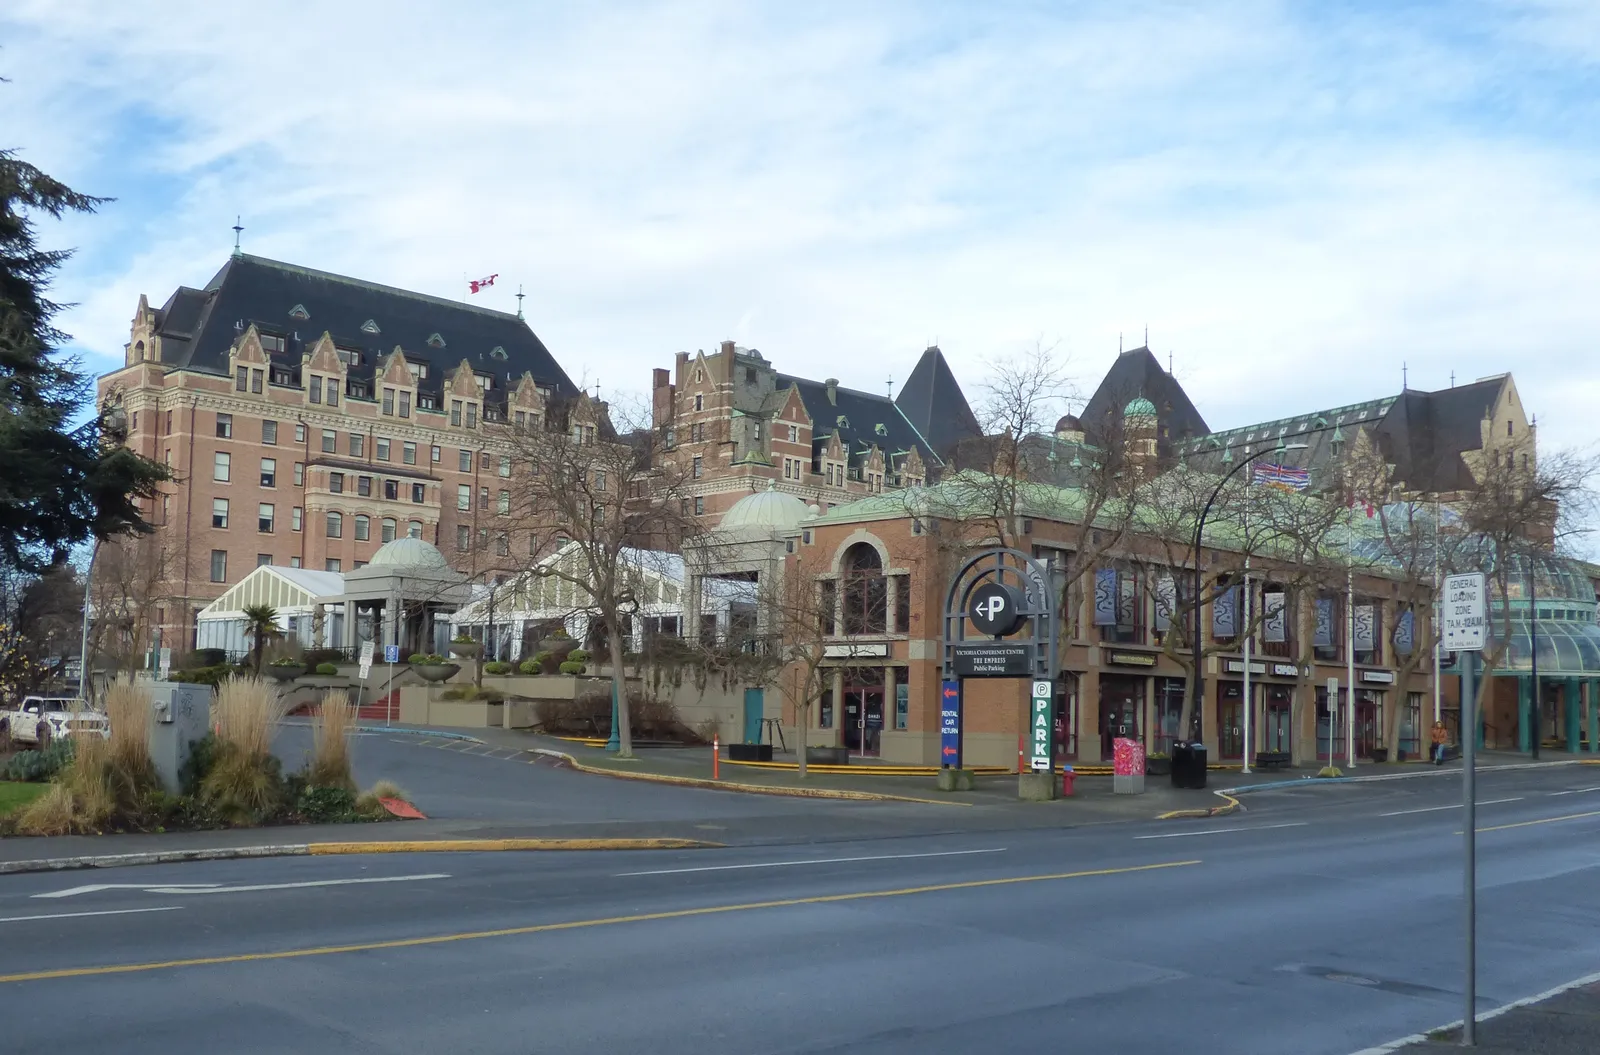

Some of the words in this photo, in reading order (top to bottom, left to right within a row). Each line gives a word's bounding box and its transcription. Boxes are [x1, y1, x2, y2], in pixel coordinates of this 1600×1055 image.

[1449, 579, 1478, 590] GENERAL
[1450, 591, 1476, 603] LOADING
[988, 596, 1005, 622] P
[1455, 605, 1472, 615] ZONE
[1035, 699, 1047, 756] PARK
